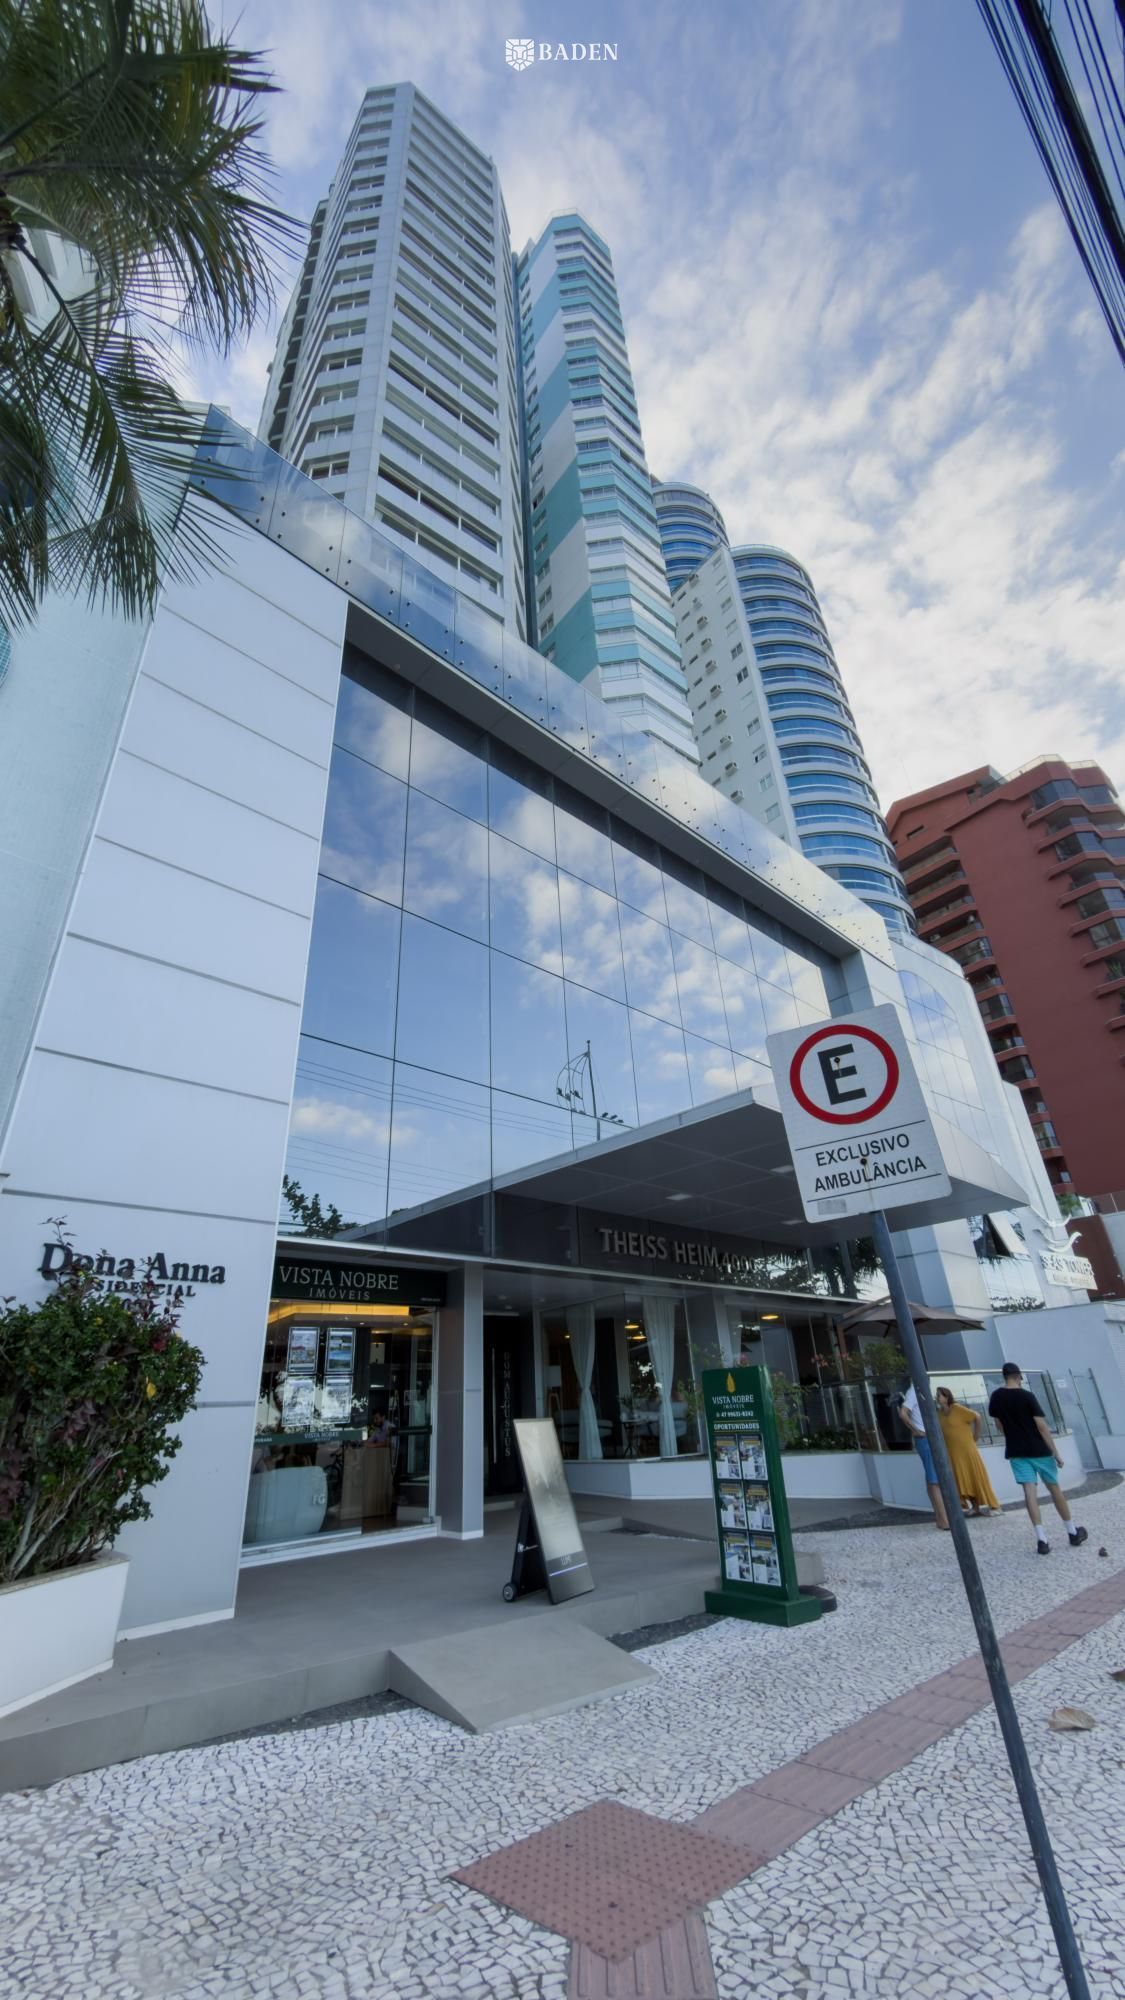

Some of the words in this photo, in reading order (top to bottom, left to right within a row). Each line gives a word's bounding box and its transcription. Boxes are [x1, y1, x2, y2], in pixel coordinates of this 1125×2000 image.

[817, 1043, 867, 1106] E
[815, 1133, 910, 1167] EXCLUSIVO
[814, 1156, 927, 1193] AMBULÂNCIA
[37, 1242, 137, 1280] Dona
[144, 1252, 226, 1285] Anna
[600, 1227, 668, 1260] THEISS
[674, 1240, 719, 1268] HEIM
[279, 1265, 334, 1287] VISTA
[340, 1270, 399, 1291] NOBRE
[309, 1287, 371, 1301] IMÓVEIS
[712, 1395, 731, 1405] VISTA
[732, 1394, 755, 1404] NOBRE
[713, 1422, 760, 1430] OPORTUNIDADES
